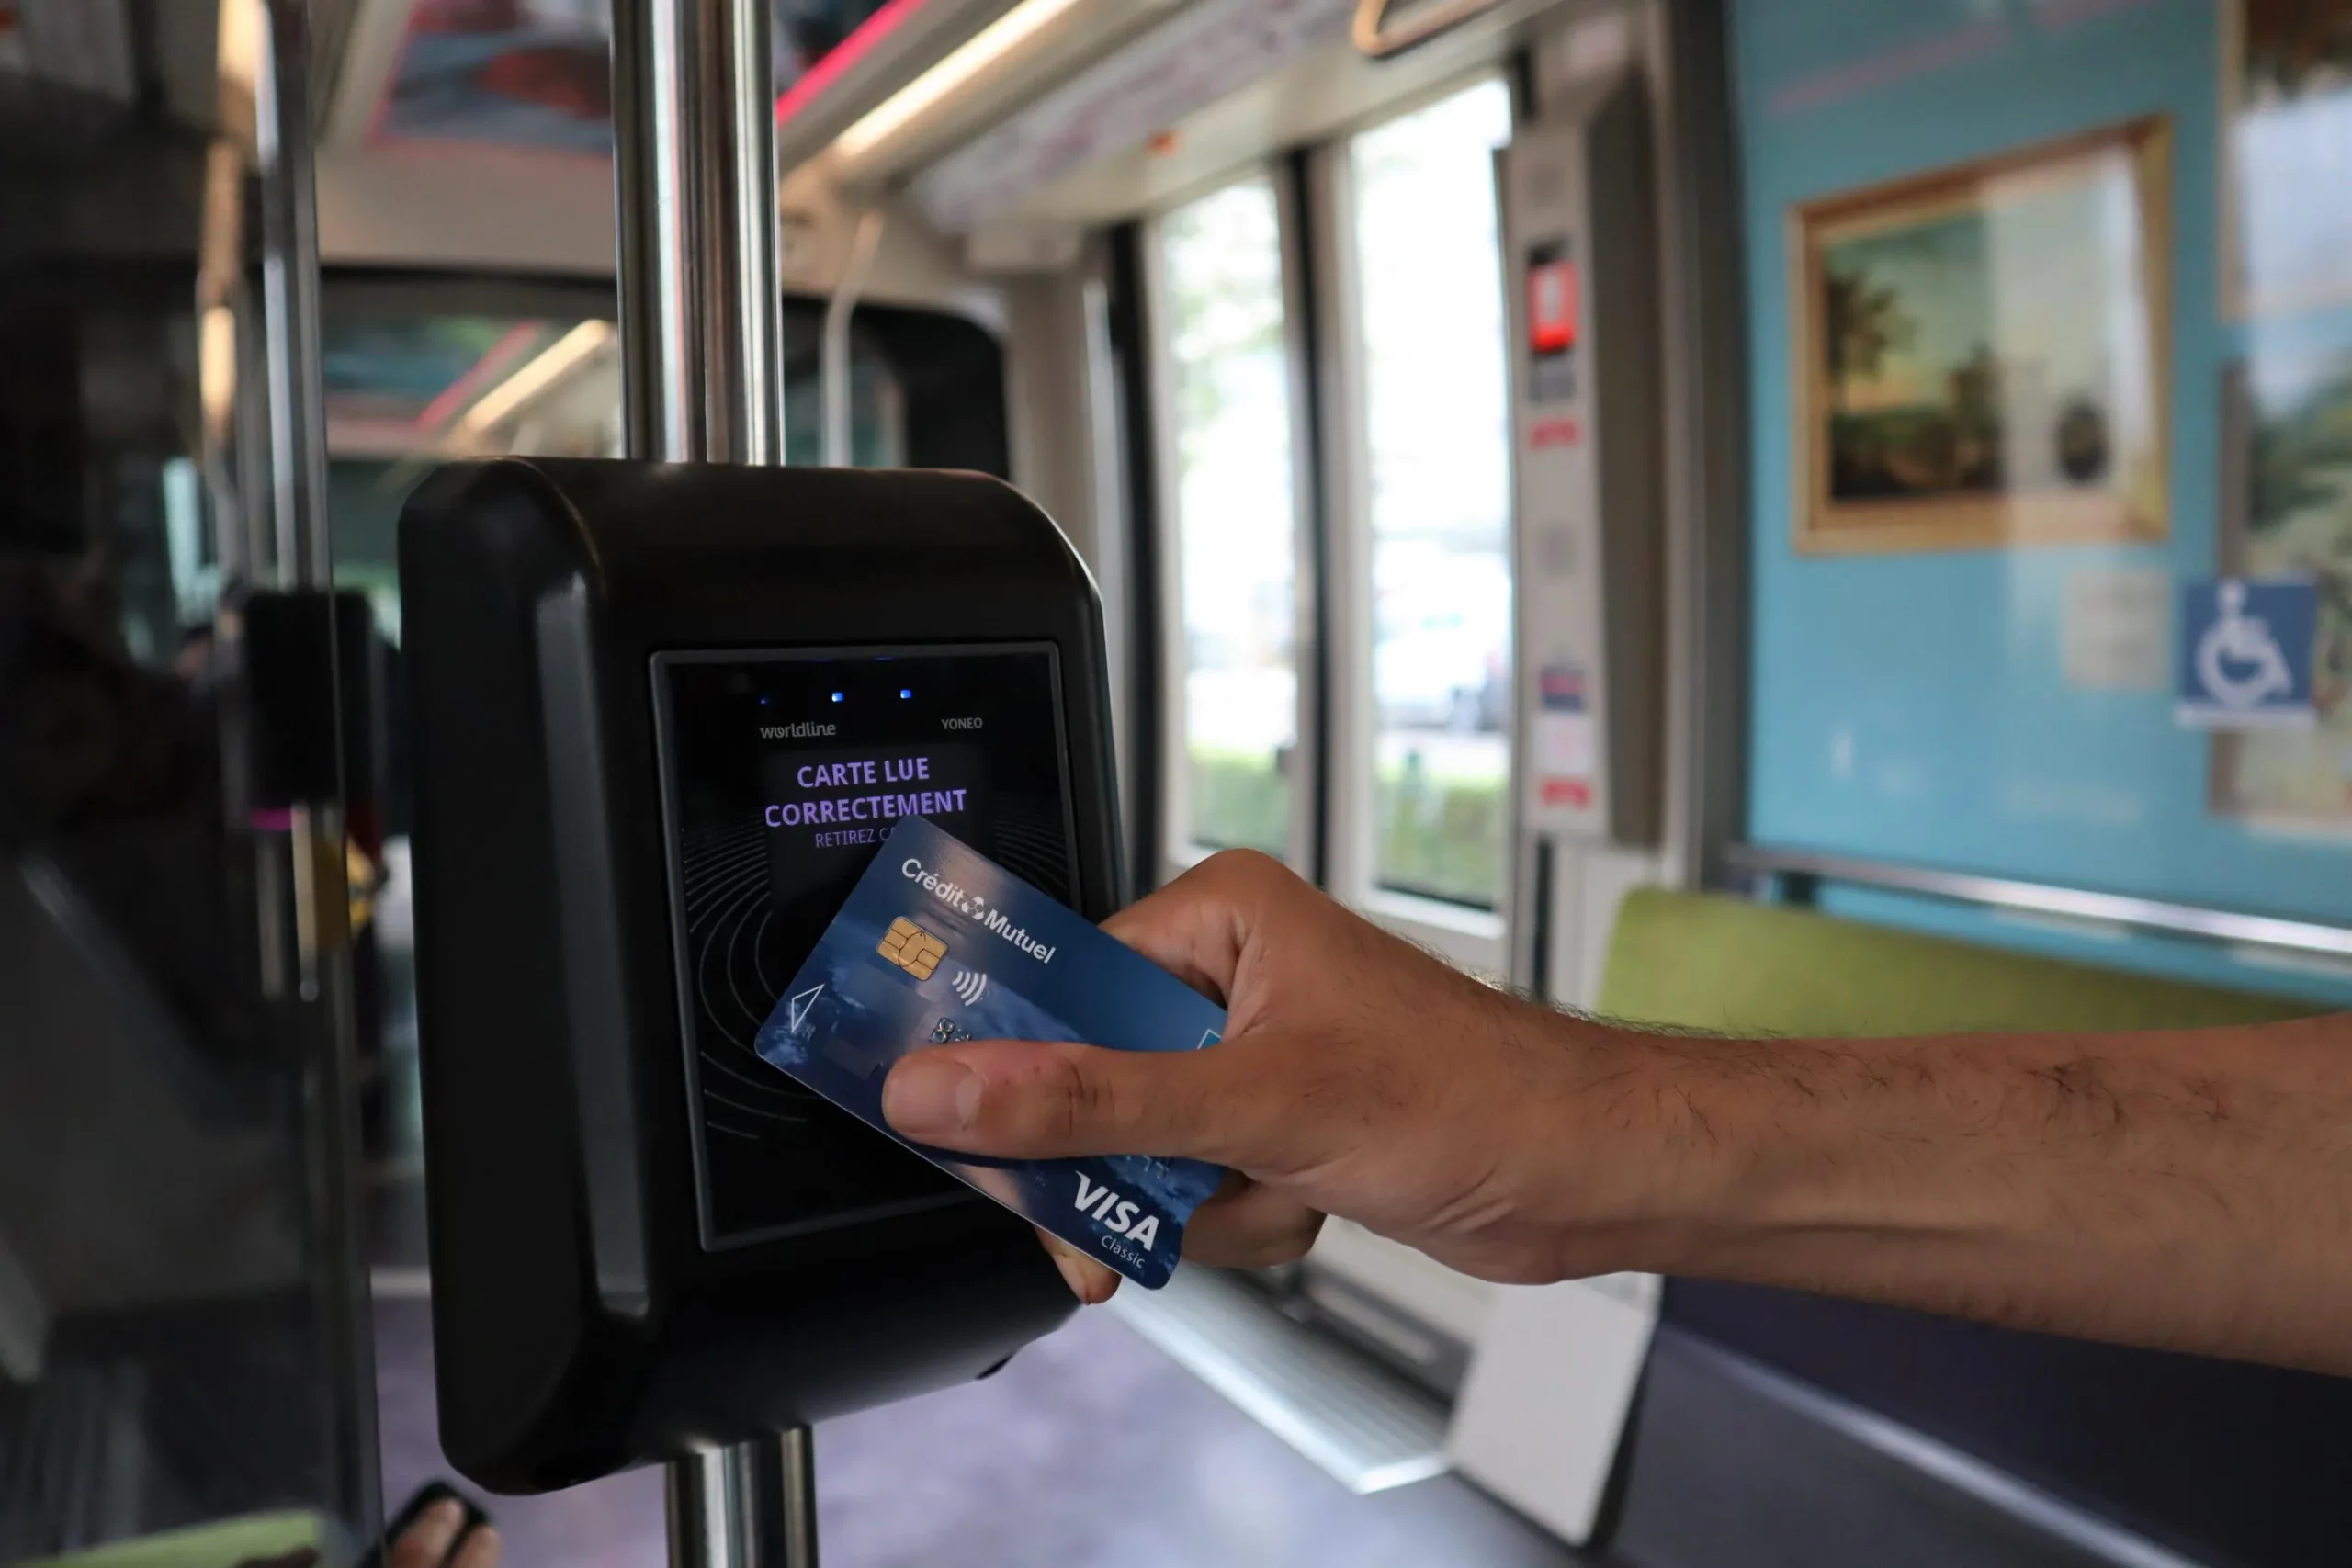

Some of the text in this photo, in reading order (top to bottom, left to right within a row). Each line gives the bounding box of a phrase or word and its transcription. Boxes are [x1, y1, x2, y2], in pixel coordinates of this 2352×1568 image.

[760, 722, 836, 739] worldline
[942, 717, 982, 730] YONEO
[797, 758, 930, 788] CARTE LUE
[765, 789, 967, 827] CORRECTEMENT
[815, 829, 876, 849] RETIREZ
[901, 858, 1057, 964] Crédit Mutuel
[1074, 1169, 1159, 1252] VISA
[1101, 1235, 1146, 1269] Classic
